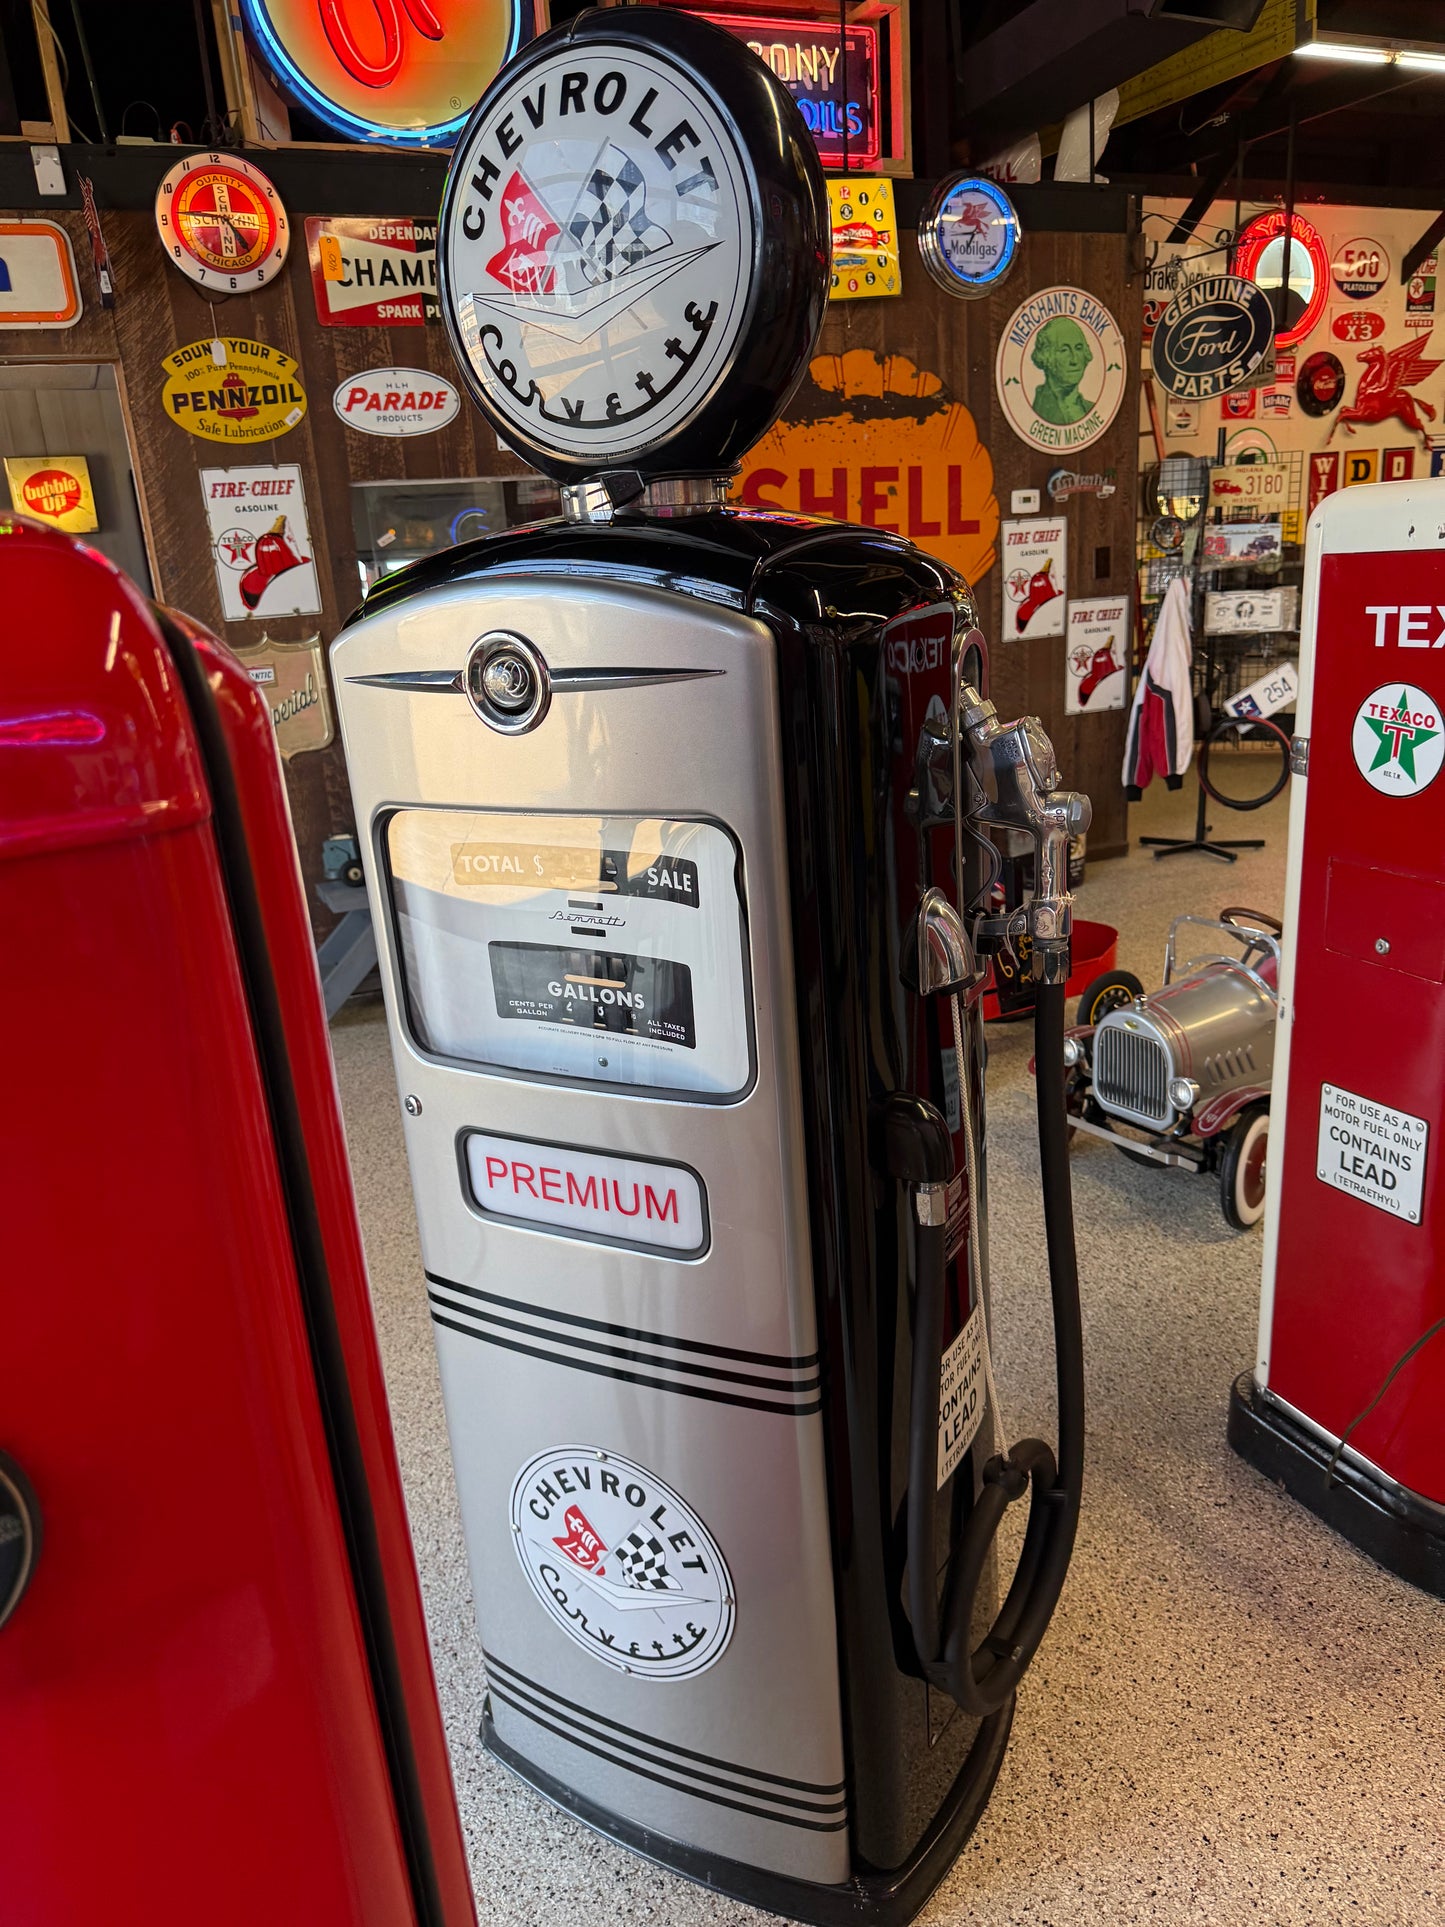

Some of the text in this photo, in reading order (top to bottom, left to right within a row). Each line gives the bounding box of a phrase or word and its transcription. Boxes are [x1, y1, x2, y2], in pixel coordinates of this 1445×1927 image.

[182, 161, 190, 171] 11
[209, 154, 221, 164] 12
[462, 71, 720, 241] CHEVROLET
[163, 183, 173, 194] 10
[196, 175, 245, 189] QUALITY
[266, 187, 274, 198] 2
[840, 187, 850, 199] 12
[161, 214, 168, 223] 9
[279, 218, 285, 229] 3
[875, 209, 882, 221] 2
[174, 246, 181, 258] 8
[275, 248, 282, 259] 4
[950, 239, 998, 260] Mobilgas
[205, 253, 253, 268] CHICAGO
[1344, 250, 1380, 278] 500
[199, 268, 206, 280] 7
[229, 277, 237, 289] 6
[257, 270, 264, 282] 5
[376, 304, 422, 319] SPARK
[1164, 279, 1257, 326] GENUINE
[1009, 292, 1111, 348] MERCHANTS BANK
[1172, 314, 1244, 365] Ford
[172, 341, 288, 367] SOUN YOUR Z
[228, 362, 280, 380] Pennsylvania
[479, 300, 719, 430] Corvette
[1172, 359, 1245, 397] PARTS
[171, 383, 303, 414] PENNZOIL
[343, 387, 448, 412] PARADE
[196, 417, 286, 438] Safe Lubrication
[376, 414, 423, 423] PRODUCTS
[1029, 410, 1105, 446] GREEN MACHINE
[1350, 459, 1371, 482] D
[24, 476, 78, 501] bubble
[210, 479, 295, 498] FIRE-CHIEF
[1245, 474, 1283, 495] 3180
[235, 504, 279, 513] GASOLINE
[741, 464, 980, 537] SHELL
[222, 536, 254, 544] TEXACO
[1006, 529, 1062, 546] FIRE CHIEF
[1020, 549, 1049, 557] GASOLINE
[1071, 607, 1123, 624] FIRE CHIEF
[252, 670, 273, 681] NTIC
[1263, 676, 1292, 704] 254
[1368, 703, 1436, 729] TEXACO
[1382, 722, 1417, 760] T
[460, 853, 692, 893] TOTAL $ SALE
[548, 910, 626, 927] Bennett
[509, 999, 553, 1010] CENTS PER
[547, 981, 645, 1010] GALLONS
[516, 1007, 548, 1017] GALLON
[647, 1019, 686, 1033] ALL TAXES
[648, 1027, 686, 1041] INCLUDED
[1335, 1093, 1411, 1132] FOR USE AS A
[1324, 1104, 1422, 1151] MOTOR FUEL ONLY
[1330, 1125, 1412, 1172] CONTAINS
[1340, 1150, 1397, 1191] LEAD
[485, 1156, 679, 1224] PREMIUM
[952, 1339, 966, 1362] USE
[966, 1327, 974, 1341] AS
[956, 1347, 971, 1377] FUEL
[944, 1387, 977, 1454] LEAD
[529, 1466, 709, 1575] CHEVROLET
[539, 1563, 708, 1661] Corvette
